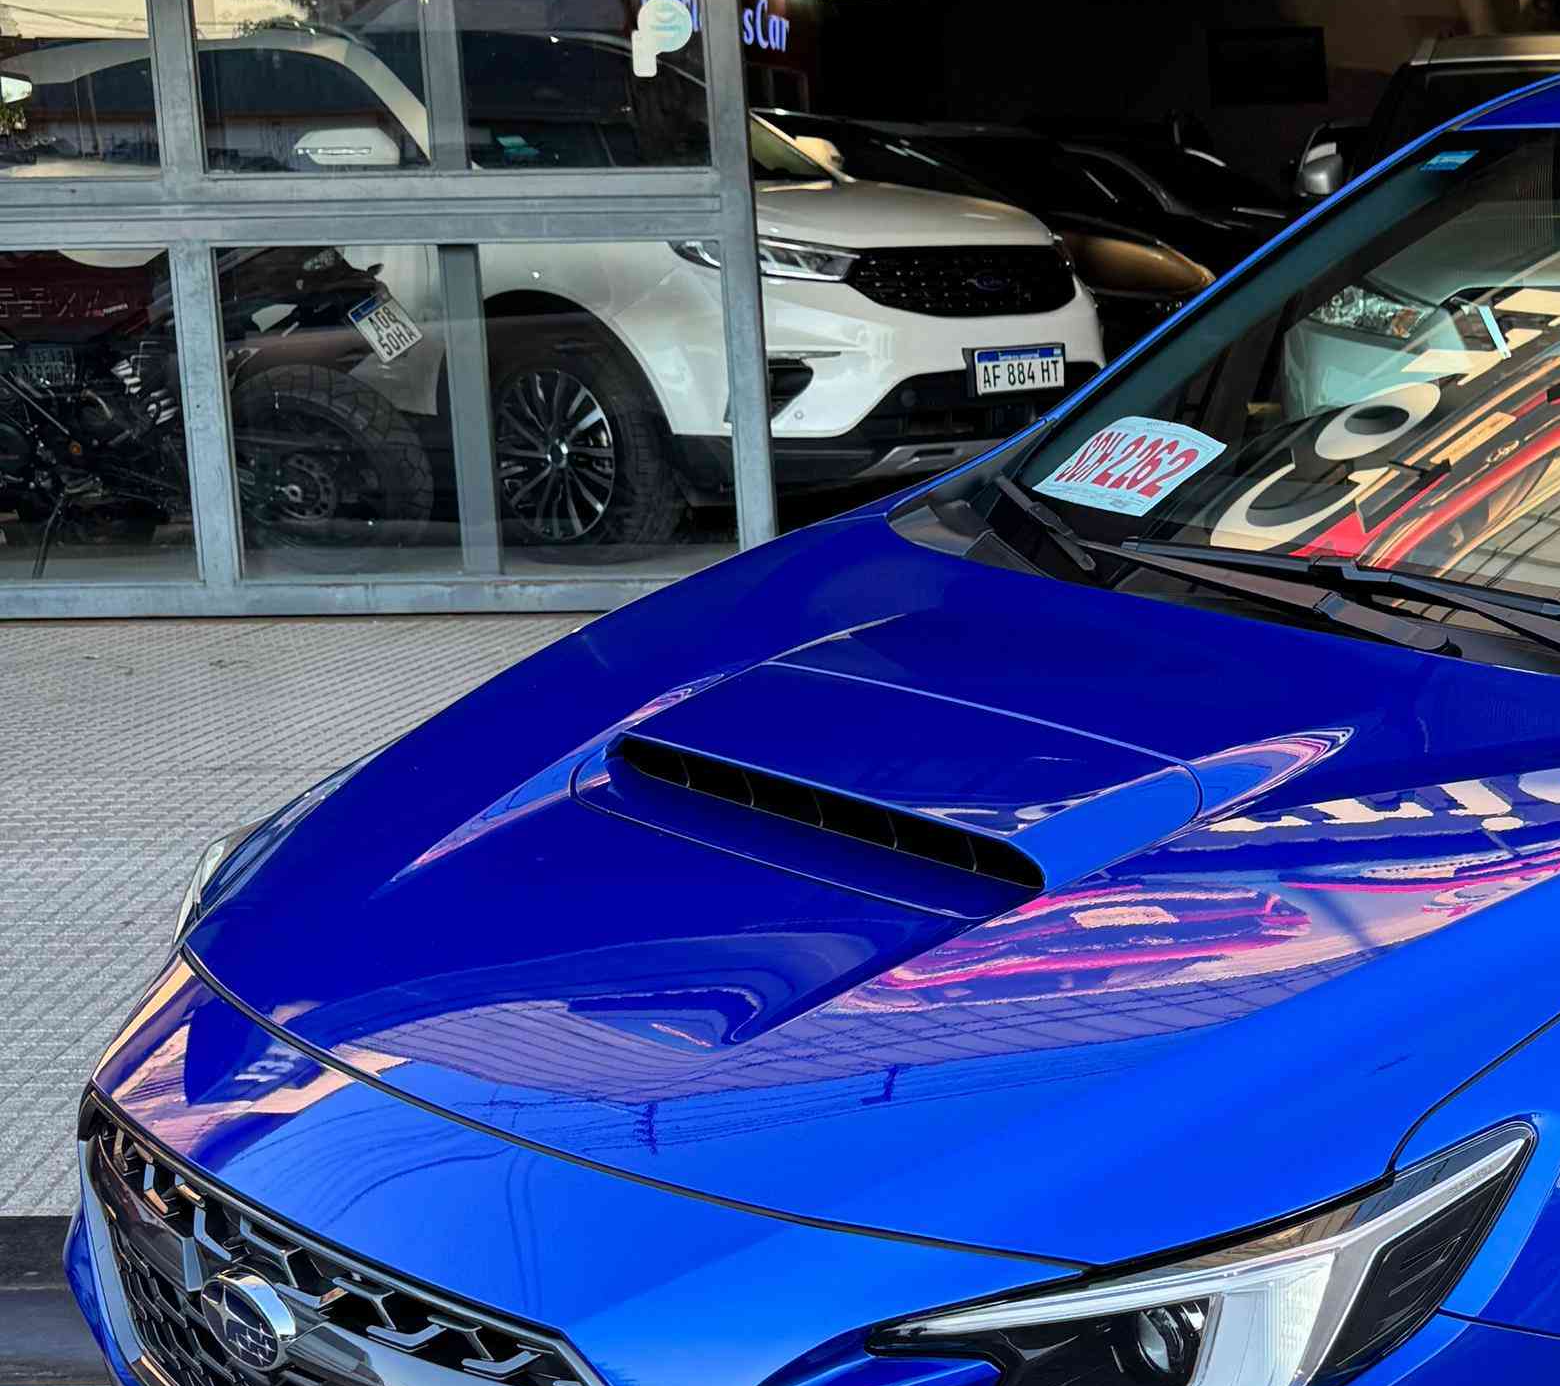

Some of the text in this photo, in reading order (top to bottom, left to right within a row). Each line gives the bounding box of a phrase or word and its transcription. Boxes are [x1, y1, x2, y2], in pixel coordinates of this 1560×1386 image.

[982, 359, 1060, 389] AF 884 HT
